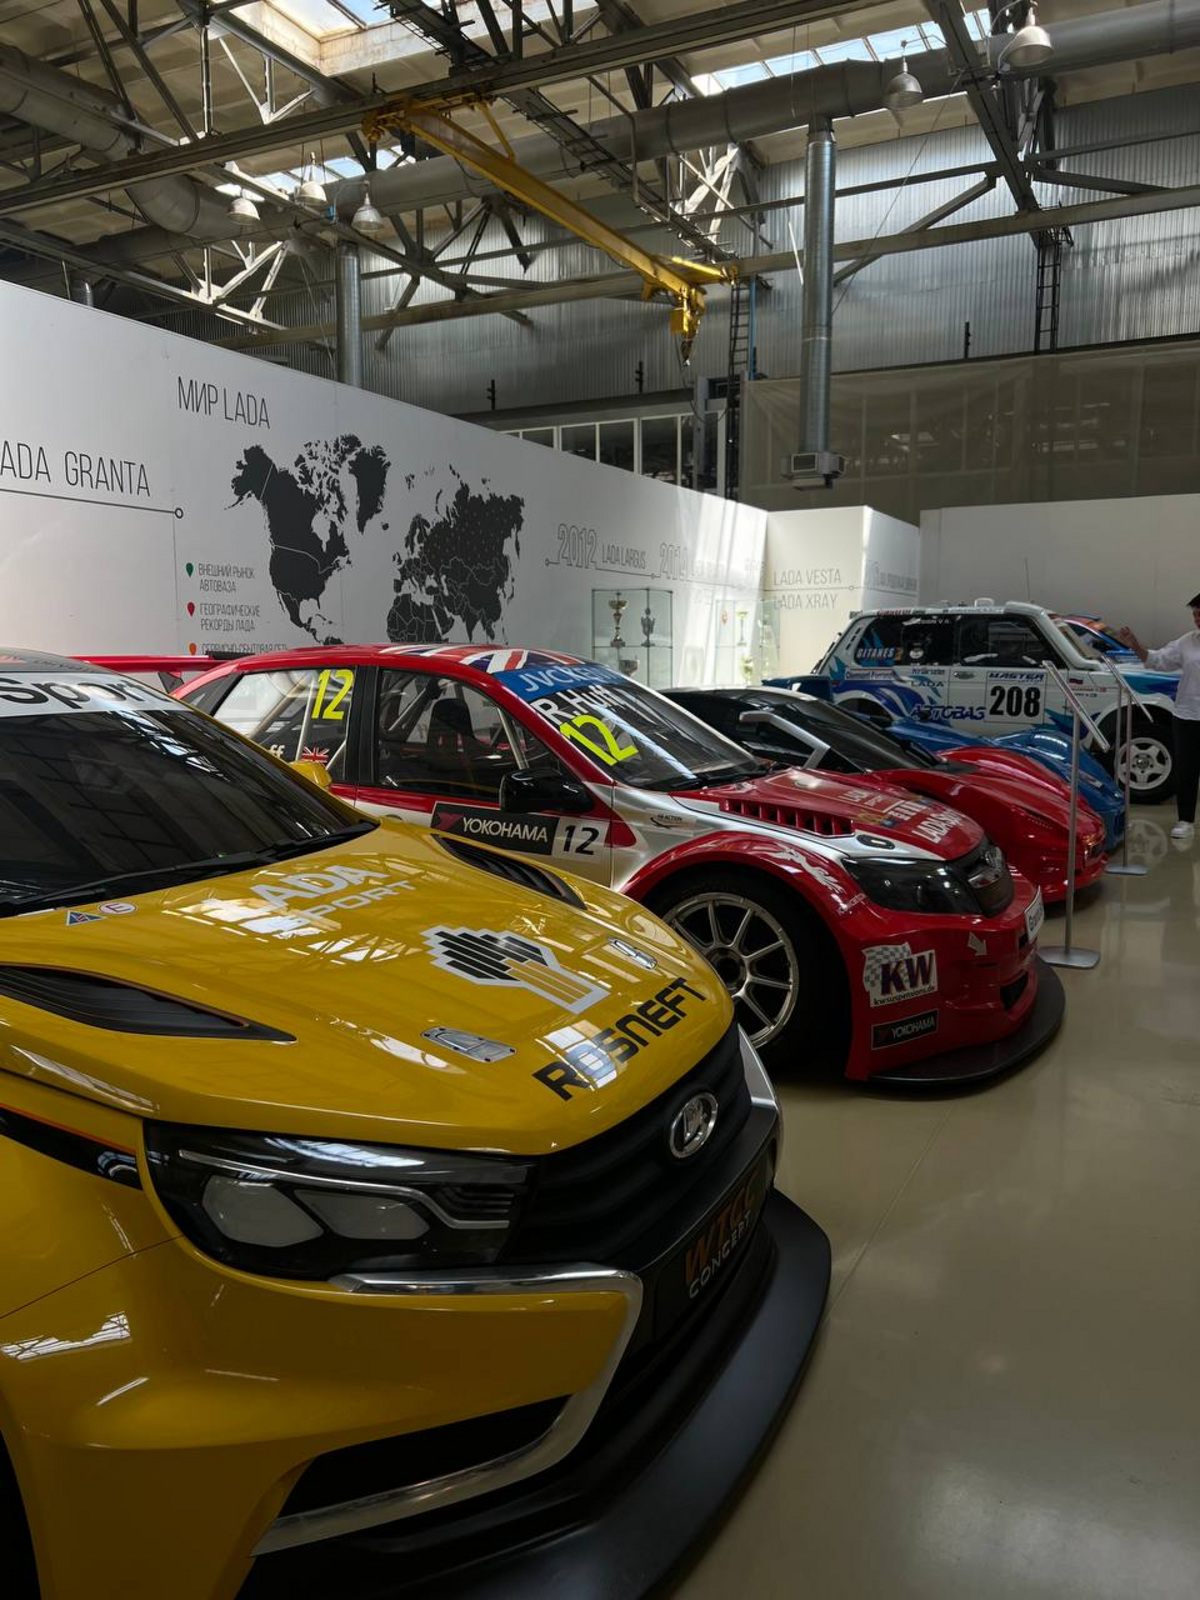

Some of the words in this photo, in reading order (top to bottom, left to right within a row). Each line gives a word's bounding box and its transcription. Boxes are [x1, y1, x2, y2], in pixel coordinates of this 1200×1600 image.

[178, 376, 218, 415] МИР
[224, 389, 270, 429] LADA
[65, 451, 150, 497] GRANTA
[557, 523, 598, 569] 2012
[773, 570, 801, 586] LADA
[805, 569, 841, 585] VESTA
[774, 595, 801, 610] LADA
[805, 594, 838, 610] XRAY
[311, 669, 355, 720] 12
[990, 685, 1041, 717] 208
[560, 715, 638, 766] 12
[462, 816, 548, 843] YOKOHAMA
[563, 824, 599, 856] 12
[881, 953, 934, 996] KW
[532, 976, 707, 1101] ROSNEFT
[892, 1016, 935, 1039] YOKOHAMA
[690, 1209, 751, 1299] CONCEPT
